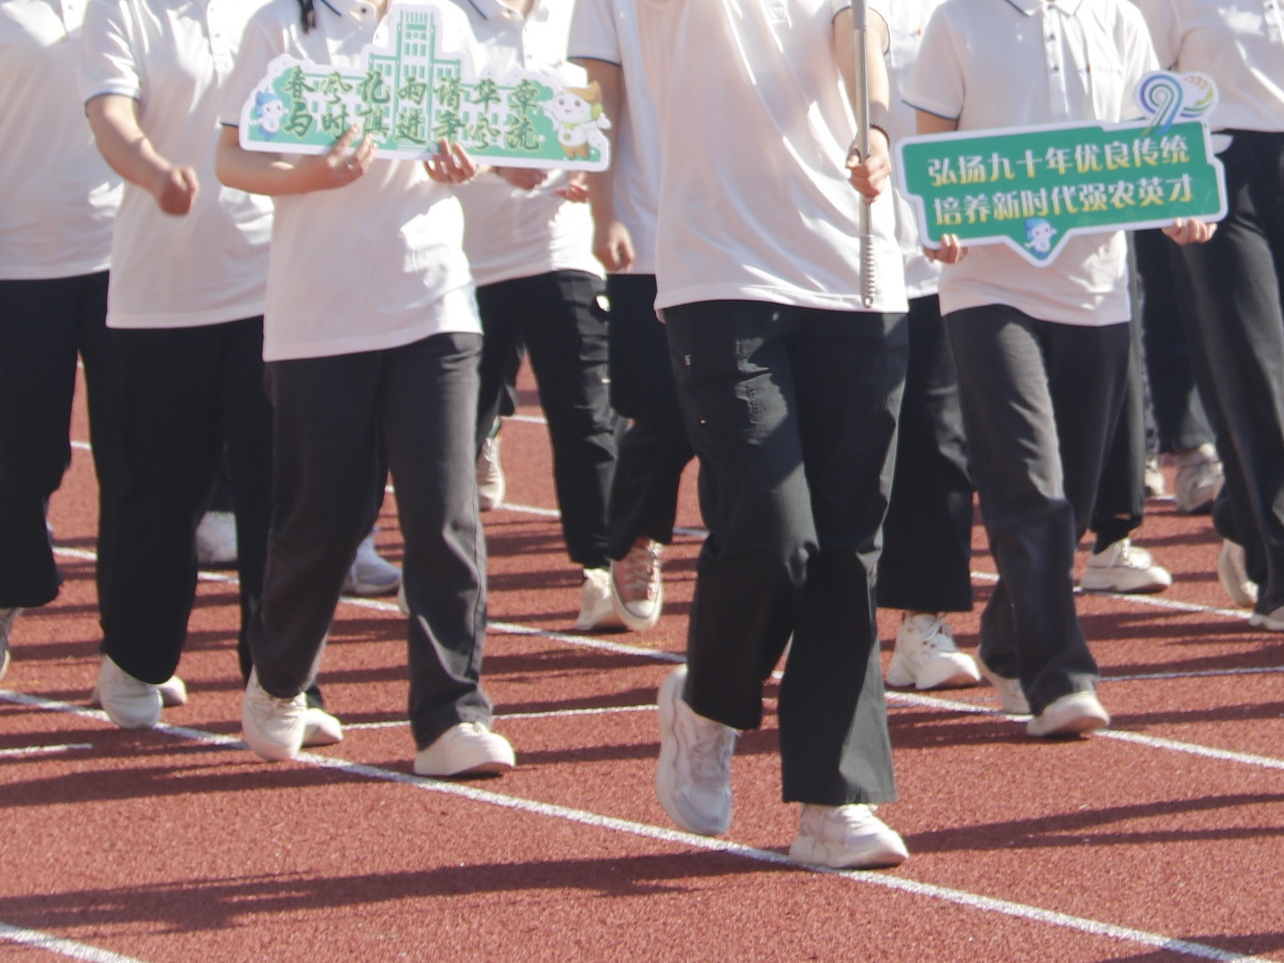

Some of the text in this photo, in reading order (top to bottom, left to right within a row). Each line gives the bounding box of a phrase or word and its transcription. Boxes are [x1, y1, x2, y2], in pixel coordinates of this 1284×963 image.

[927, 134, 1190, 187] 弘扬九十年优良传统
[933, 173, 1194, 226] 培养新时代强农英才
